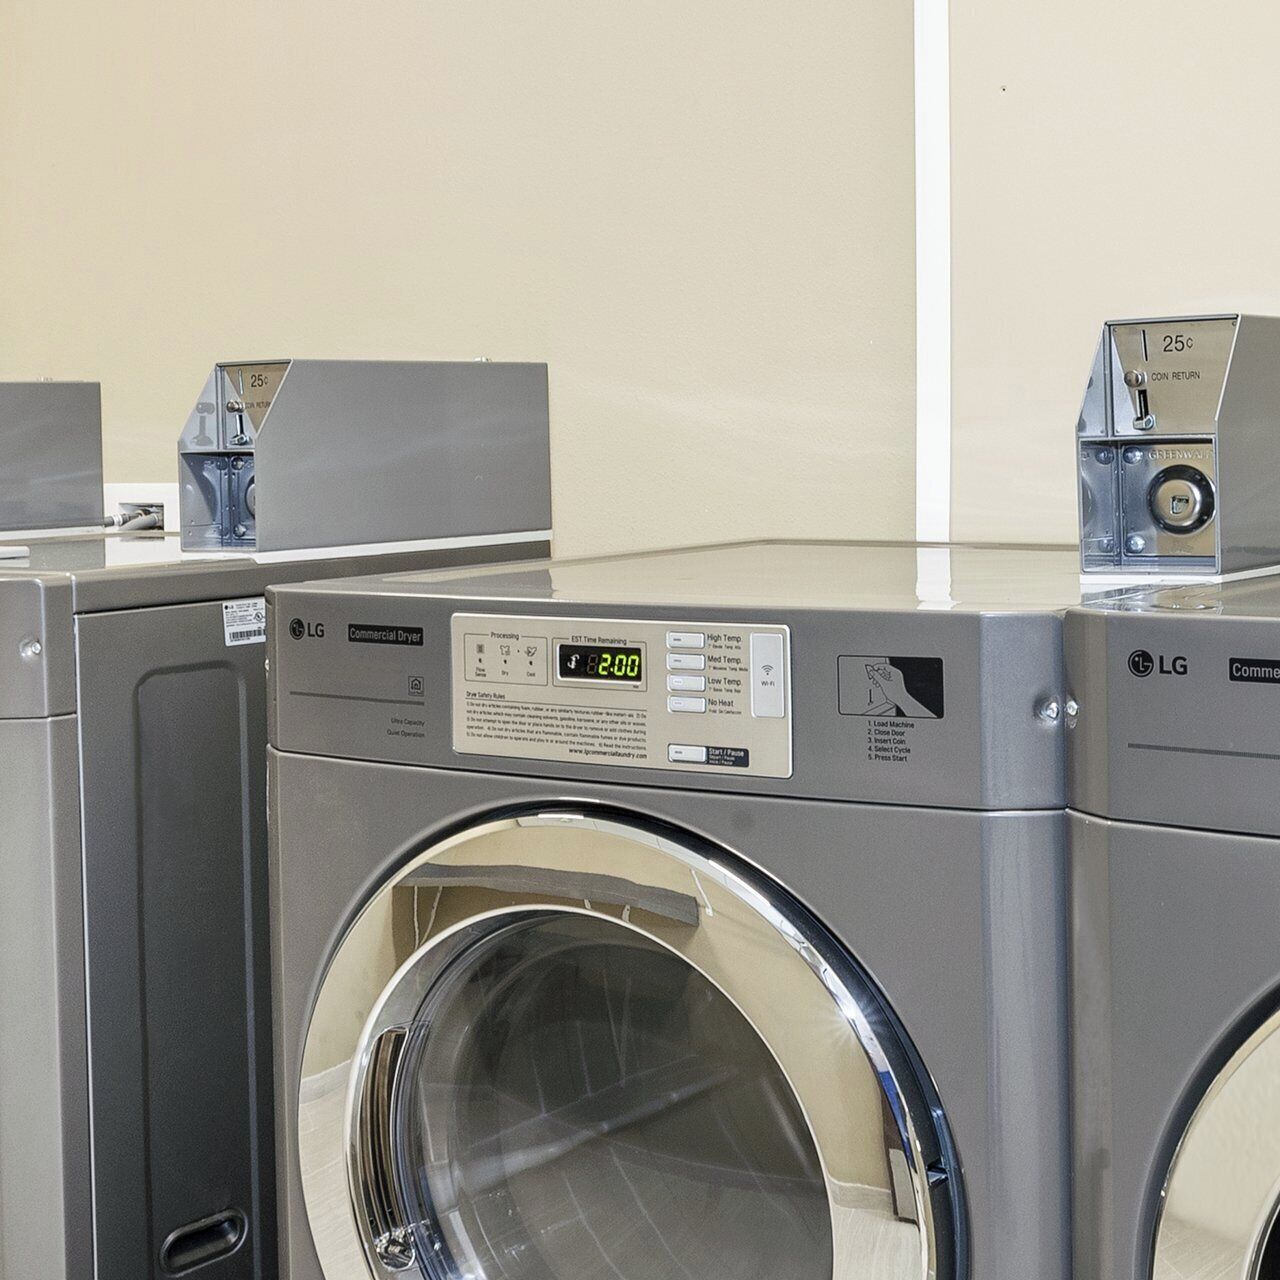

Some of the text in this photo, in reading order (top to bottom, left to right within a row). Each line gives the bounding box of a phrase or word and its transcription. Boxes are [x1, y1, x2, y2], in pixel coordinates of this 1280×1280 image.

[1163, 335, 1193, 352] 25¢
[1151, 370, 1200, 381] COIN RETURN
[308, 622, 324, 638] LG
[350, 627, 421, 643] Commercial Dryer
[491, 632, 519, 640] Processing
[1159, 655, 1188, 675] LG
